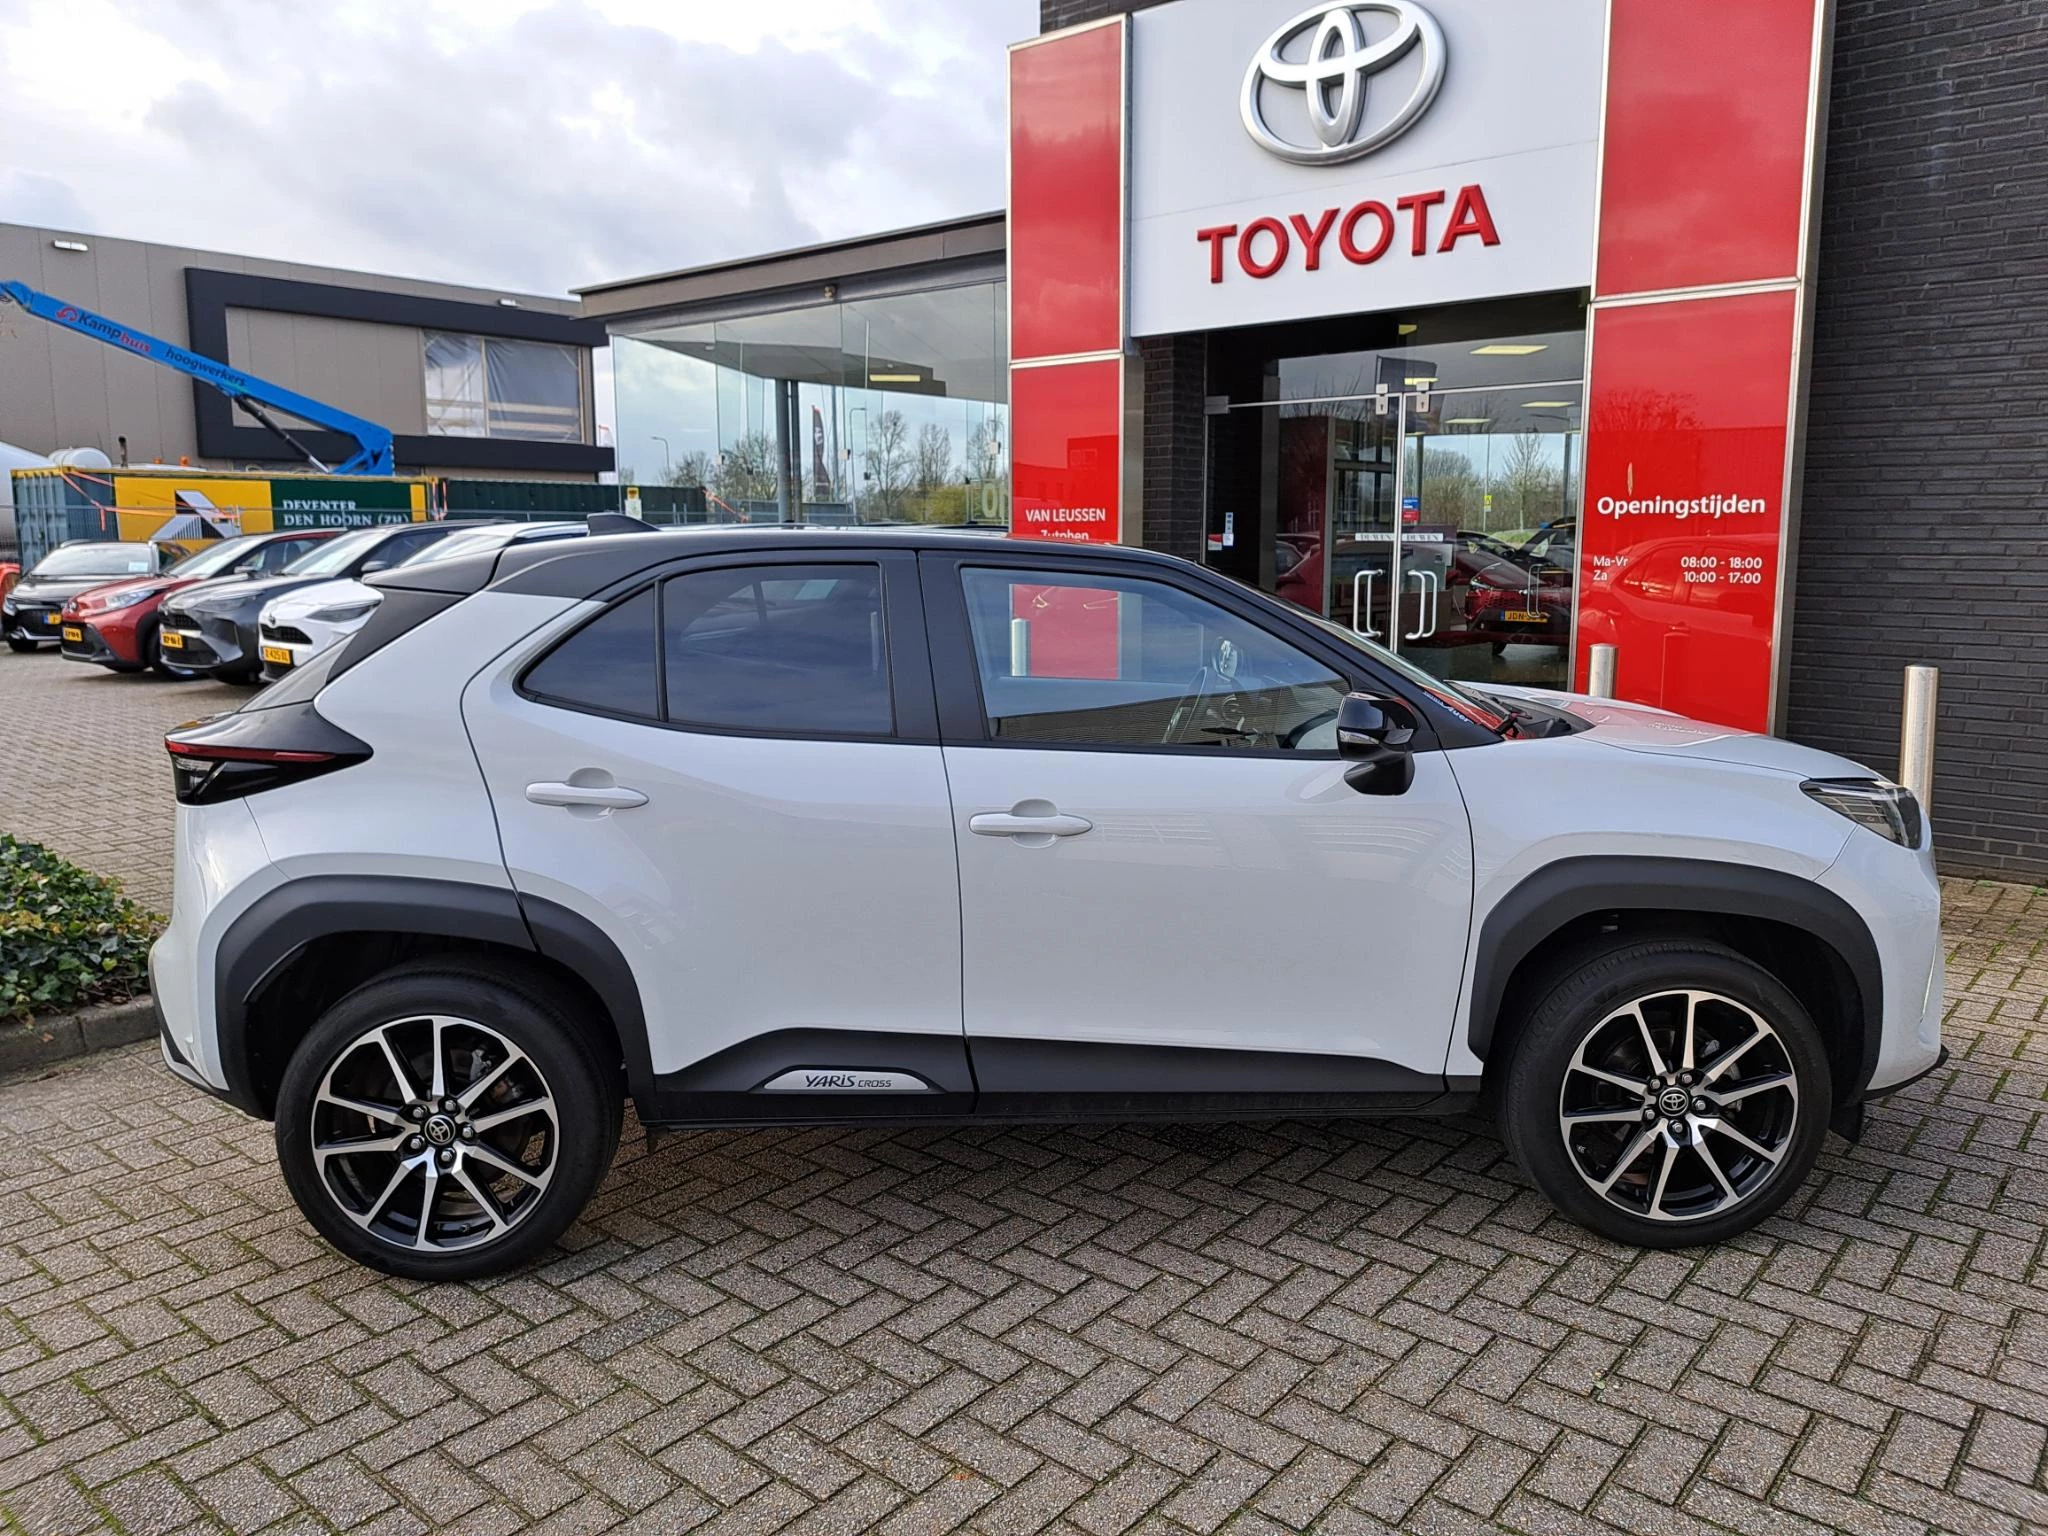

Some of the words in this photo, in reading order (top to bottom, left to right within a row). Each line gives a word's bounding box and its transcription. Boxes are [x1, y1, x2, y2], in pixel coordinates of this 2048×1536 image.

[1197, 184, 1501, 284] TOYOTA
[78, 311, 151, 353] Kamphuis
[166, 346, 246, 387] hoogwerkers
[283, 499, 357, 511] DEVENTER
[1597, 494, 1766, 520] Openingstijden
[284, 513, 314, 526] DEN
[320, 513, 372, 526] HOORN
[1025, 508, 1050, 522] VAN
[1052, 507, 1106, 522] LEUSSEN
[1593, 555, 1628, 567] Ma-Vr
[1681, 556, 1717, 568] 08:00
[1728, 557, 1763, 569] 18:00
[1593, 569, 1608, 581] Za
[1684, 571, 1717, 583] 10:00
[1728, 572, 1762, 584] 17:00
[858, 1079, 892, 1088] CROSS
